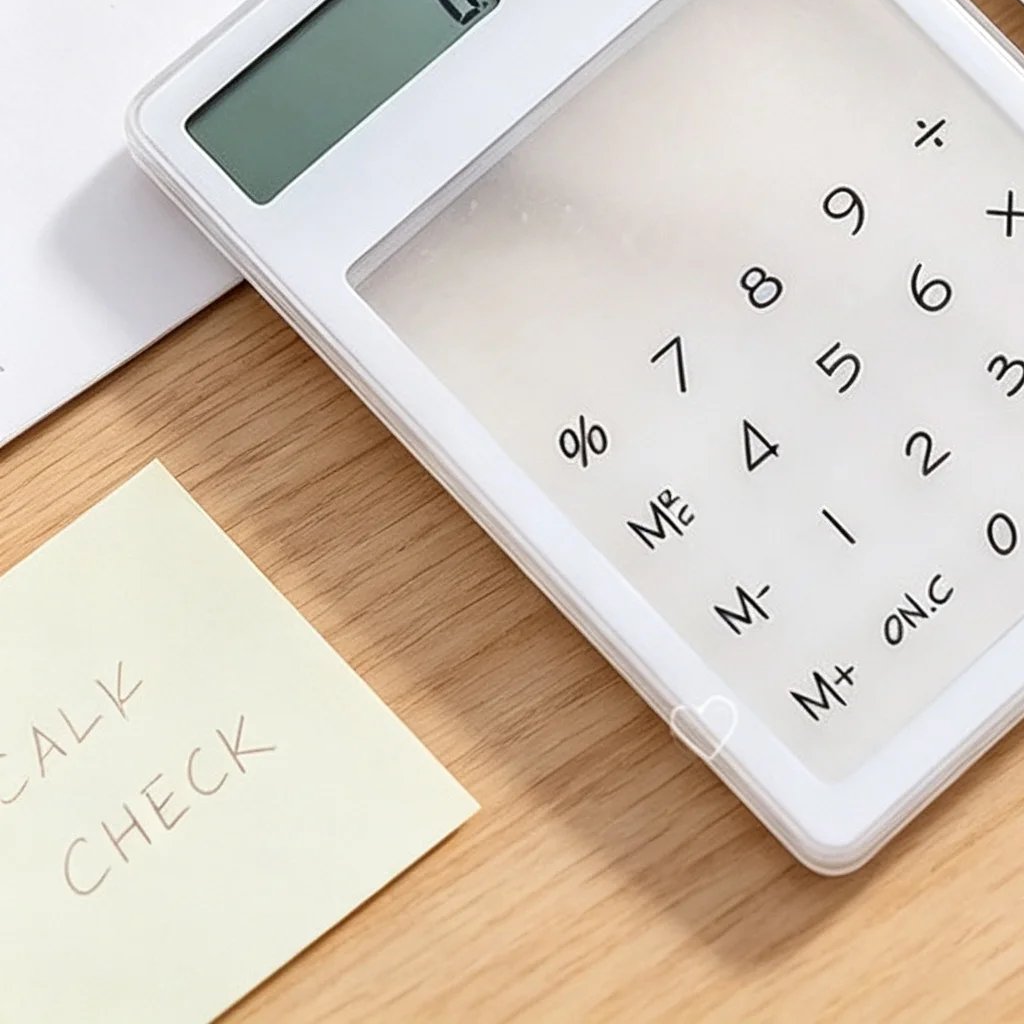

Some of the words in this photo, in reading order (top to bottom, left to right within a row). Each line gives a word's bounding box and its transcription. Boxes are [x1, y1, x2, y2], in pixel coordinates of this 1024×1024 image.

[557, 413, 610, 470] %
[649, 334, 689, 395] 7
[738, 265, 785, 311] 8
[821, 184, 867, 238] 9
[741, 417, 781, 474] 4
[814, 340, 862, 395] 5
[909, 261, 954, 314] 6
[903, 429, 953, 478] 2
[788, 664, 856, 723] M+
[985, 511, 1019, 558] 0
[64, 716, 277, 895] CHECK
